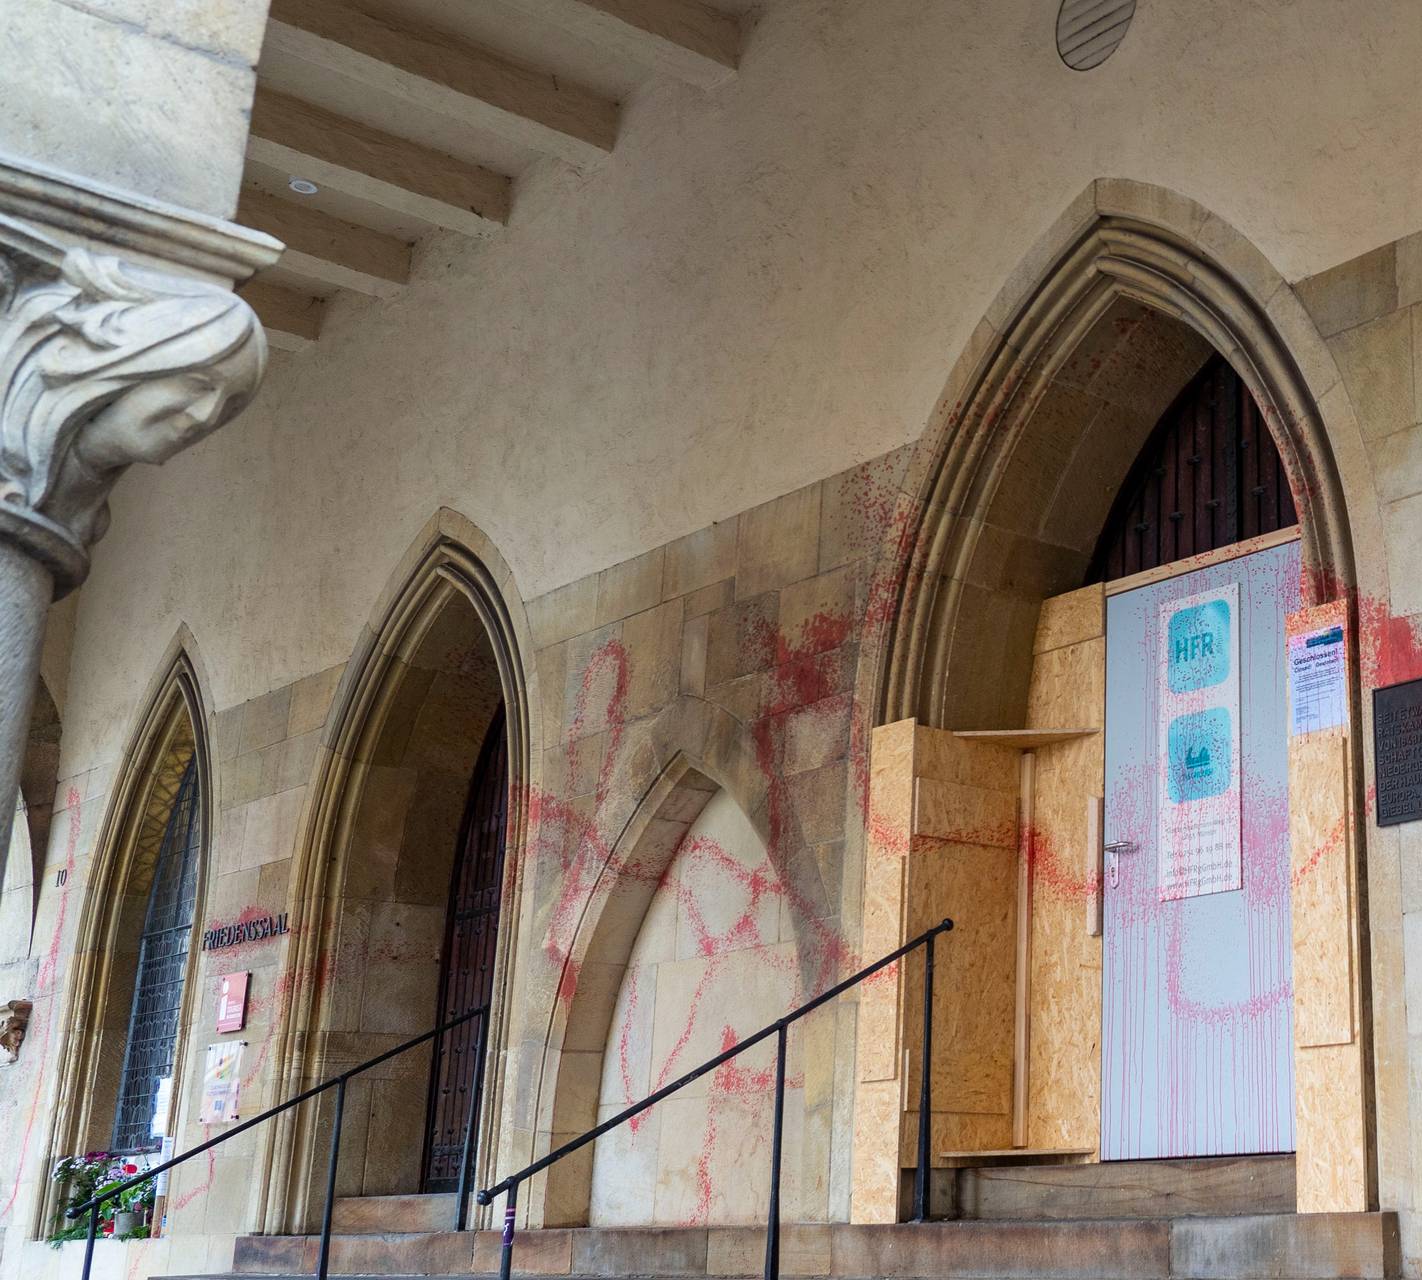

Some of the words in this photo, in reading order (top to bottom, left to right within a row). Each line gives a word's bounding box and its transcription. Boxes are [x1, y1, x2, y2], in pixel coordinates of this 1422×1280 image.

[1175, 632, 1213, 663] HFR
[55, 868, 68, 888] 10
[202, 912, 290, 951] FRIEDENSSAAL
